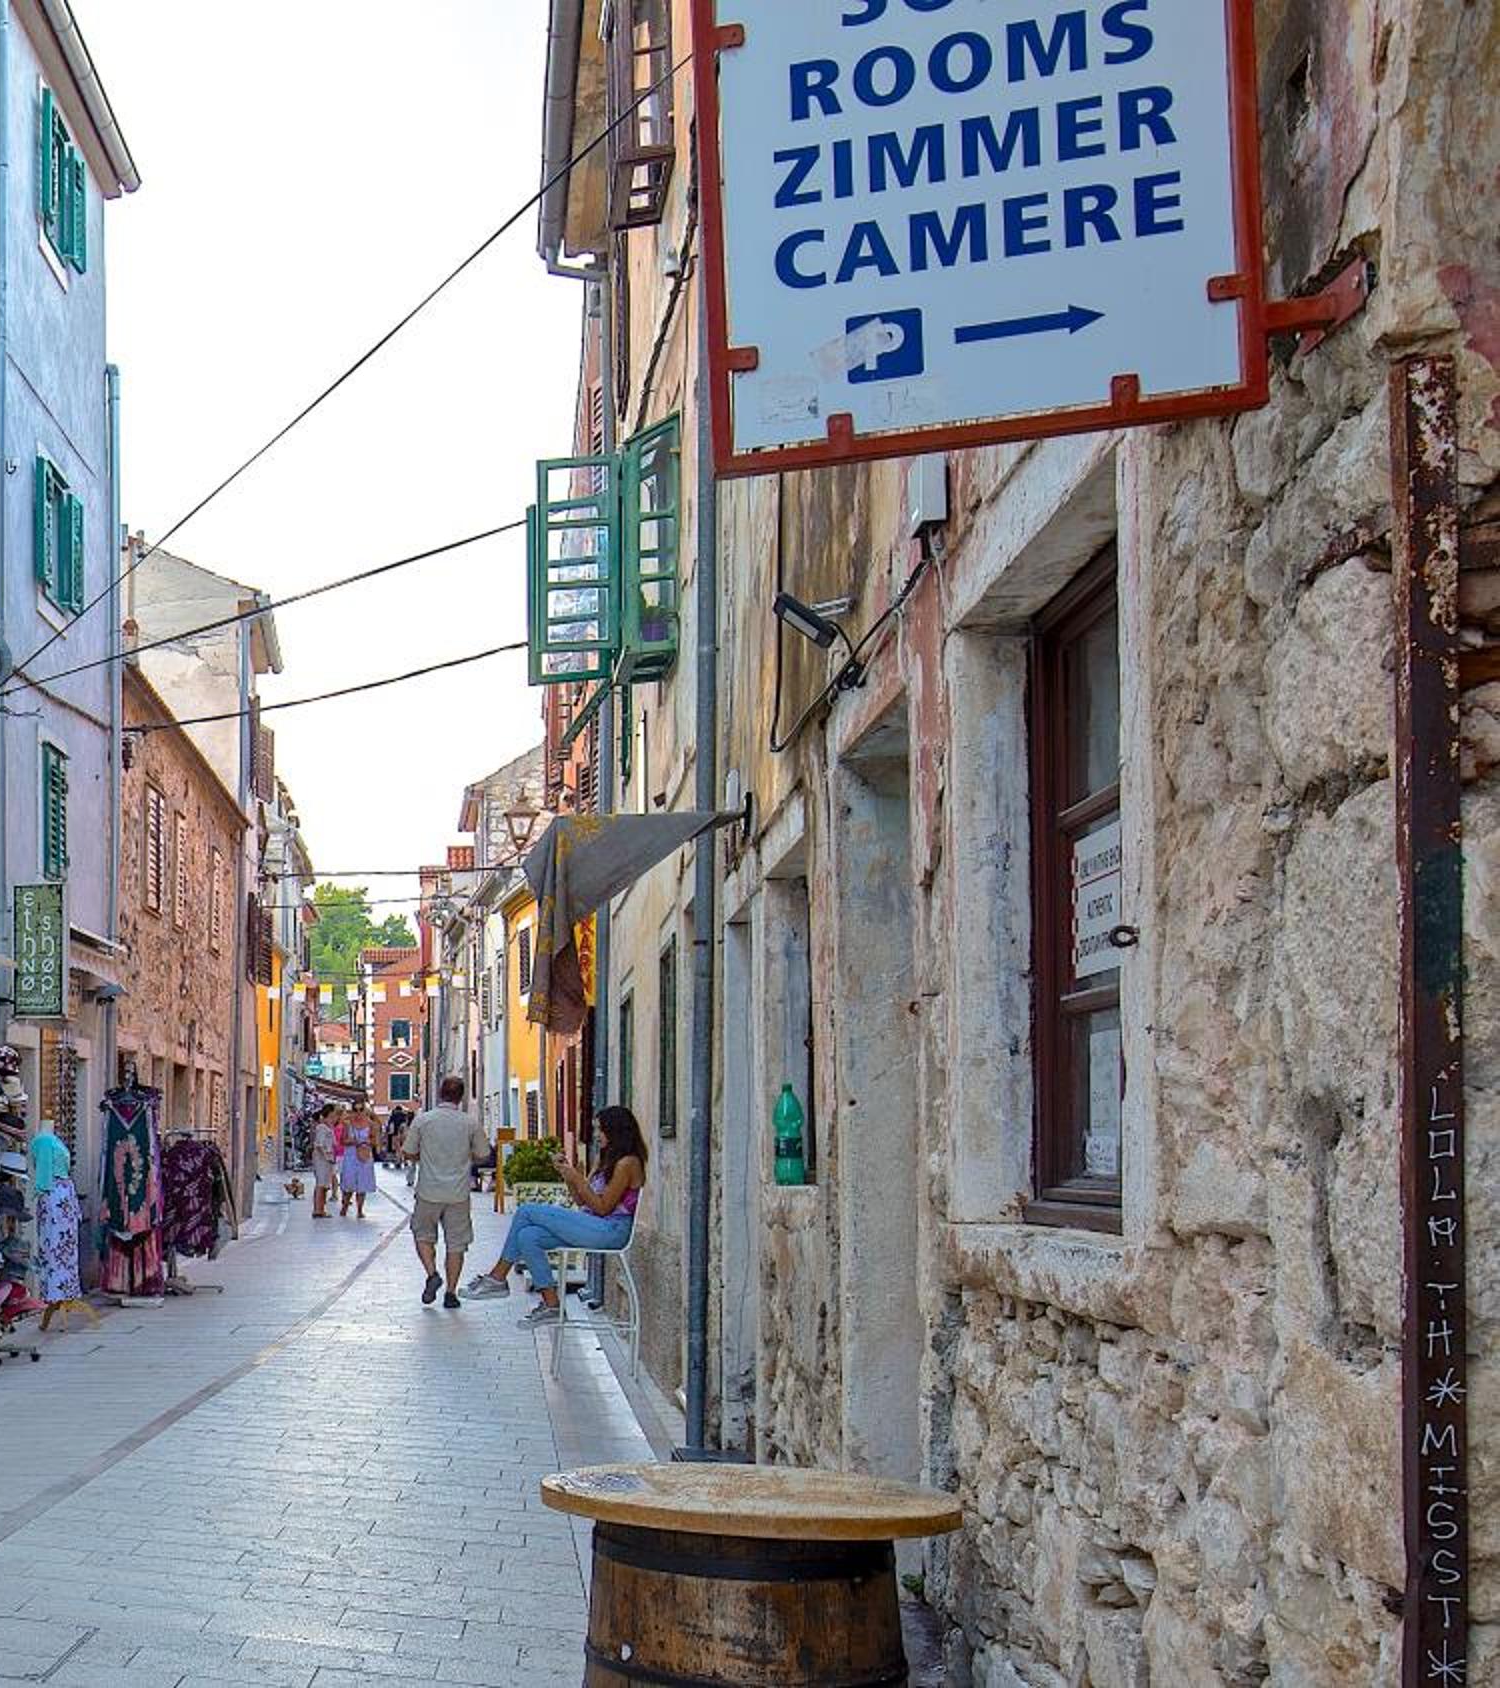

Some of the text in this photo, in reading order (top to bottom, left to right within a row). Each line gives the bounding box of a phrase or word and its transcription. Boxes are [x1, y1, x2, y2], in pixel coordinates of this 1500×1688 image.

[788, 0, 1155, 122] ROOMS
[772, 85, 1179, 209] ZIMMER
[773, 170, 1185, 289] CAMERE
